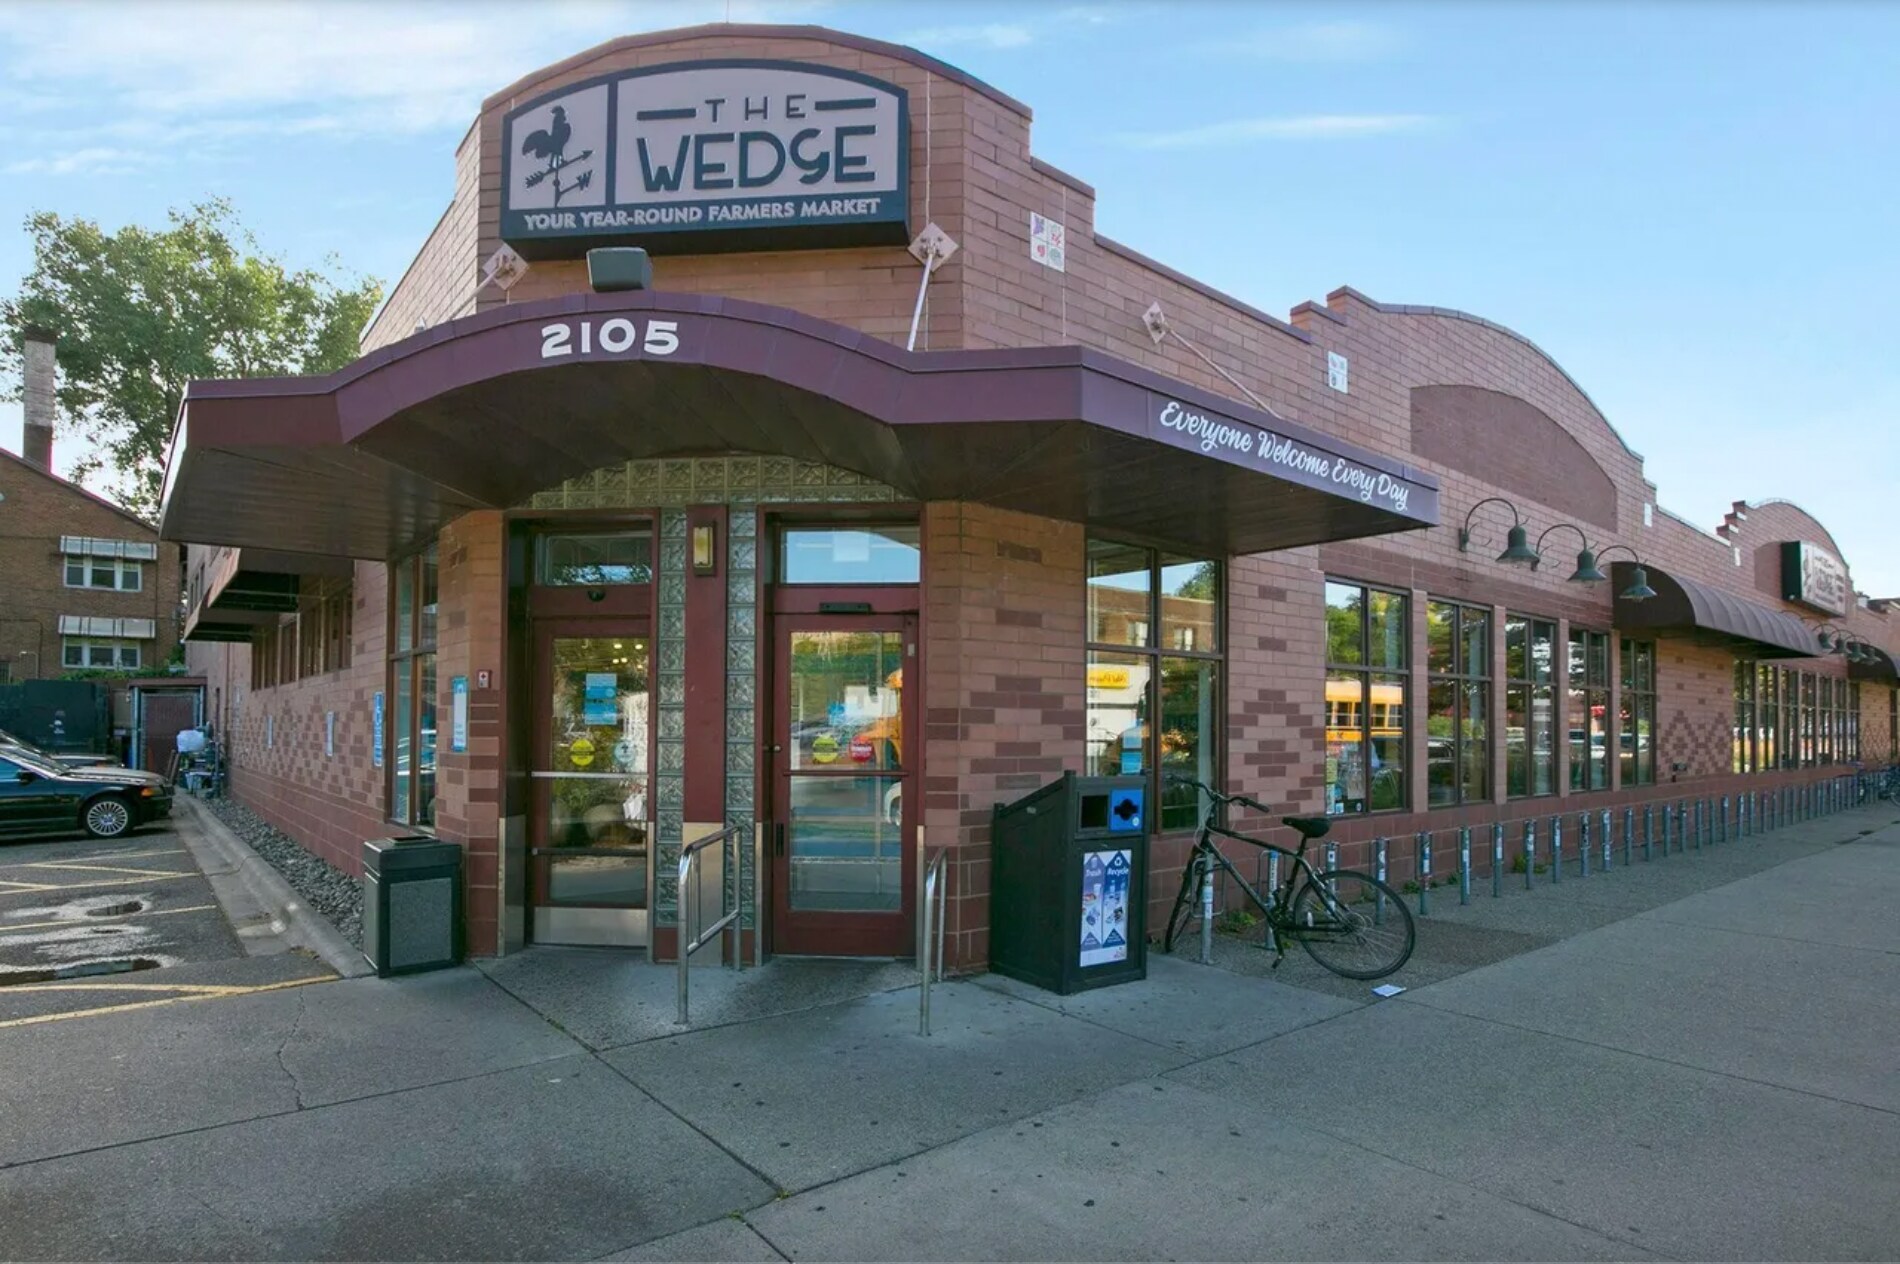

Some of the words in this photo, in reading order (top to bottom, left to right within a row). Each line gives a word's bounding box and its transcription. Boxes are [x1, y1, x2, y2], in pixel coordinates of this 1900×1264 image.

[705, 94, 806, 123] THE
[636, 125, 877, 192] WEDGE
[524, 213, 577, 231] YOUR
[579, 206, 703, 229] YEAR-ROUND
[708, 202, 795, 222] FARMERS
[800, 198, 881, 217] MARKET
[541, 318, 680, 358] 2105
[1160, 401, 1254, 452] Everyone
[1258, 431, 1330, 478] Welcome
[1332, 458, 1376, 501] Every
[1377, 473, 1409, 511] Day
